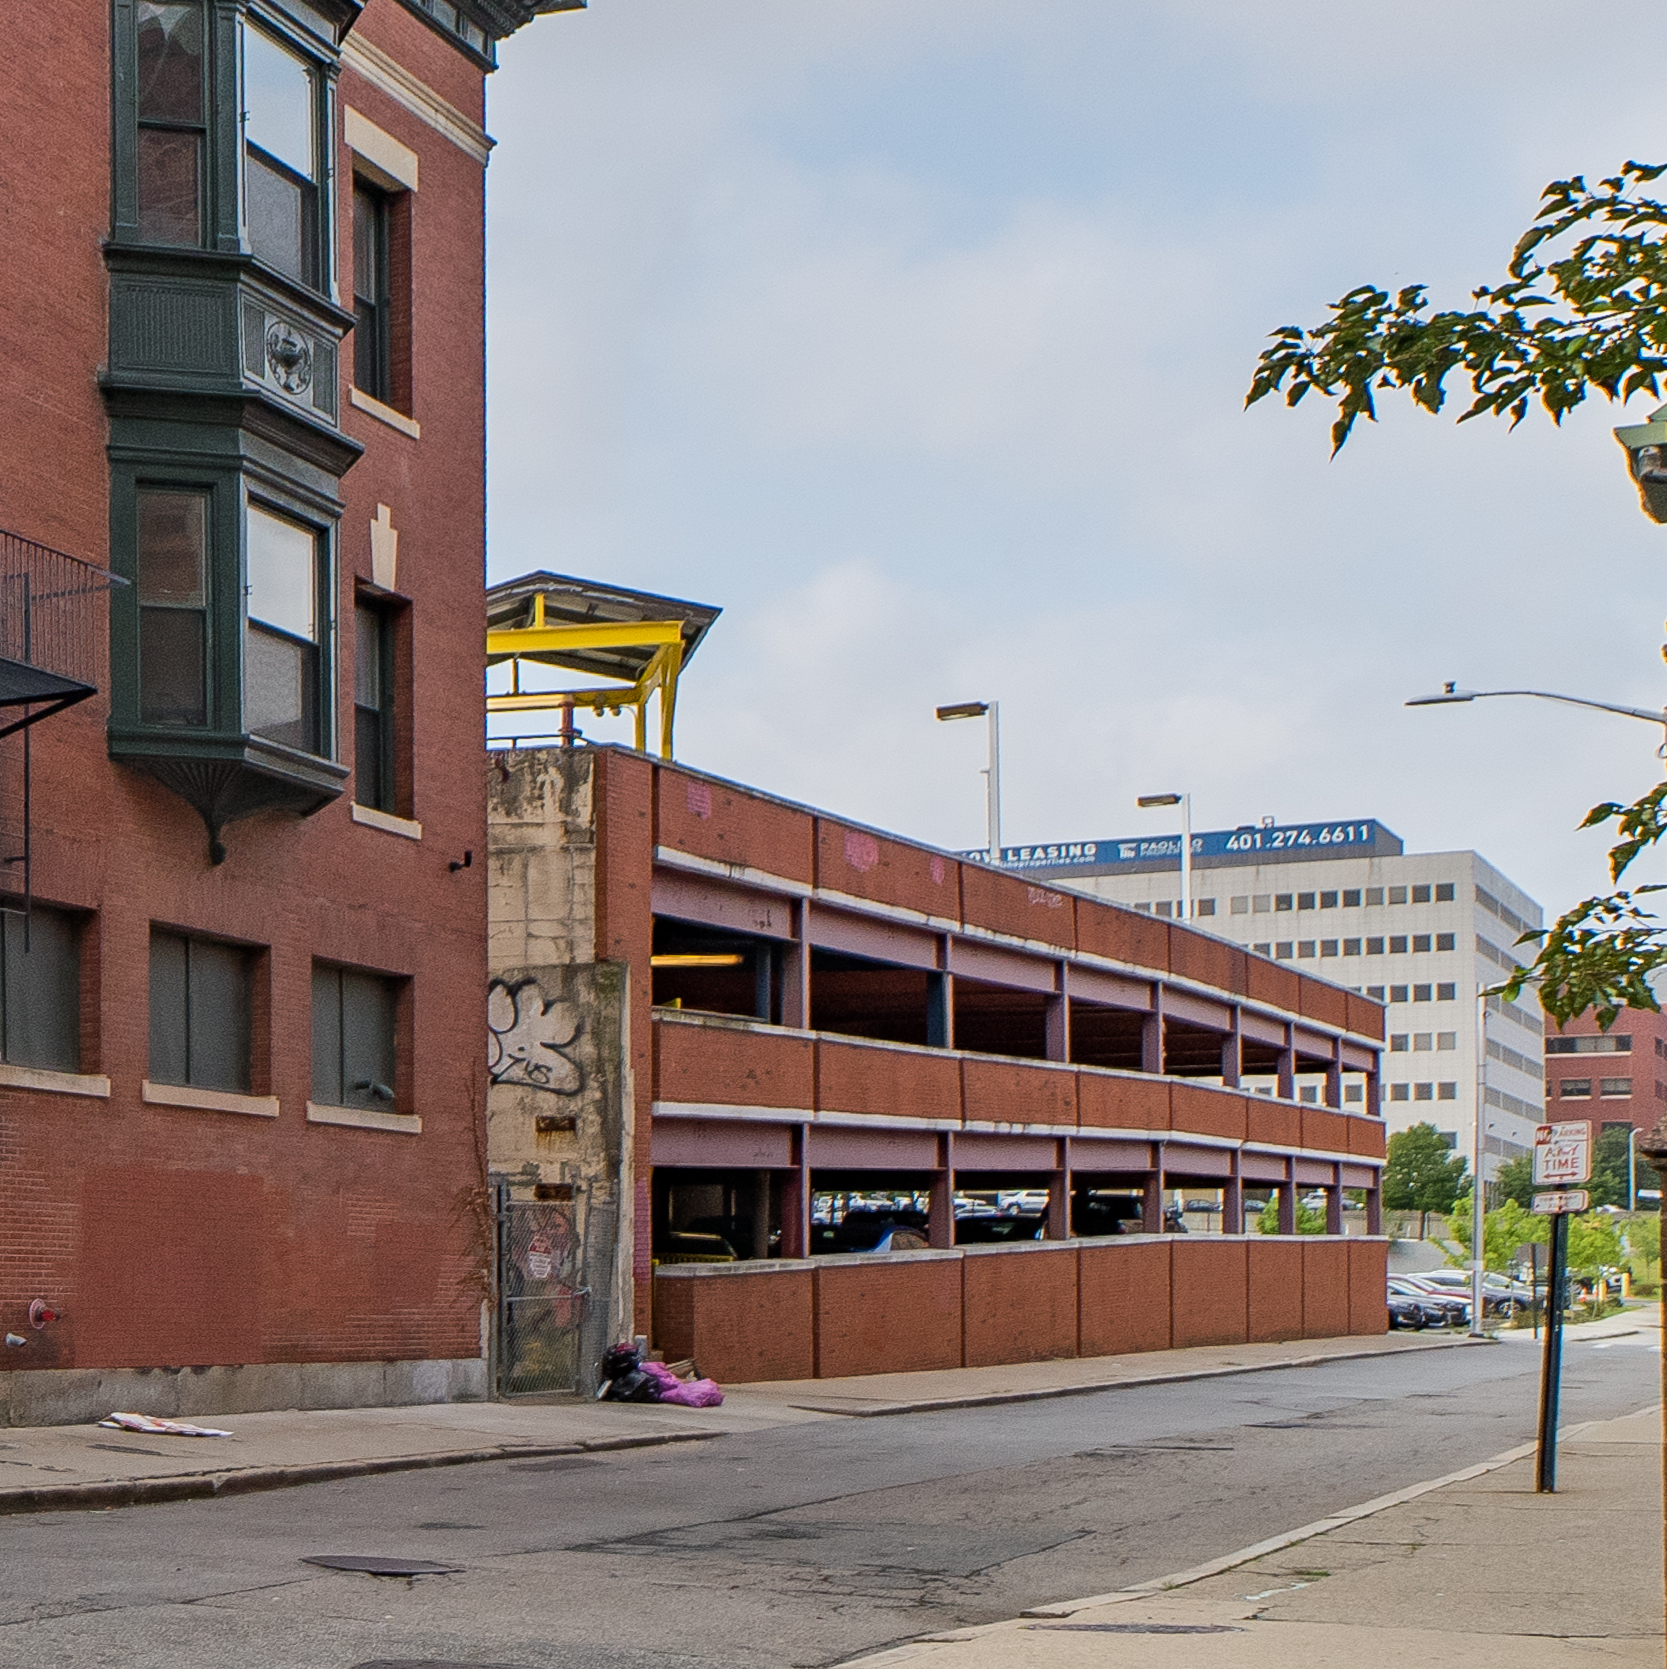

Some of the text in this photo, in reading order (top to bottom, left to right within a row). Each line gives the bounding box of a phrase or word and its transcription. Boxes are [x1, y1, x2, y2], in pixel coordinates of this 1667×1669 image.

[1225, 824, 1369, 851] 401.274.6611
[1007, 843, 1097, 861] LEASING
[1543, 1157, 1579, 1171] TIME
